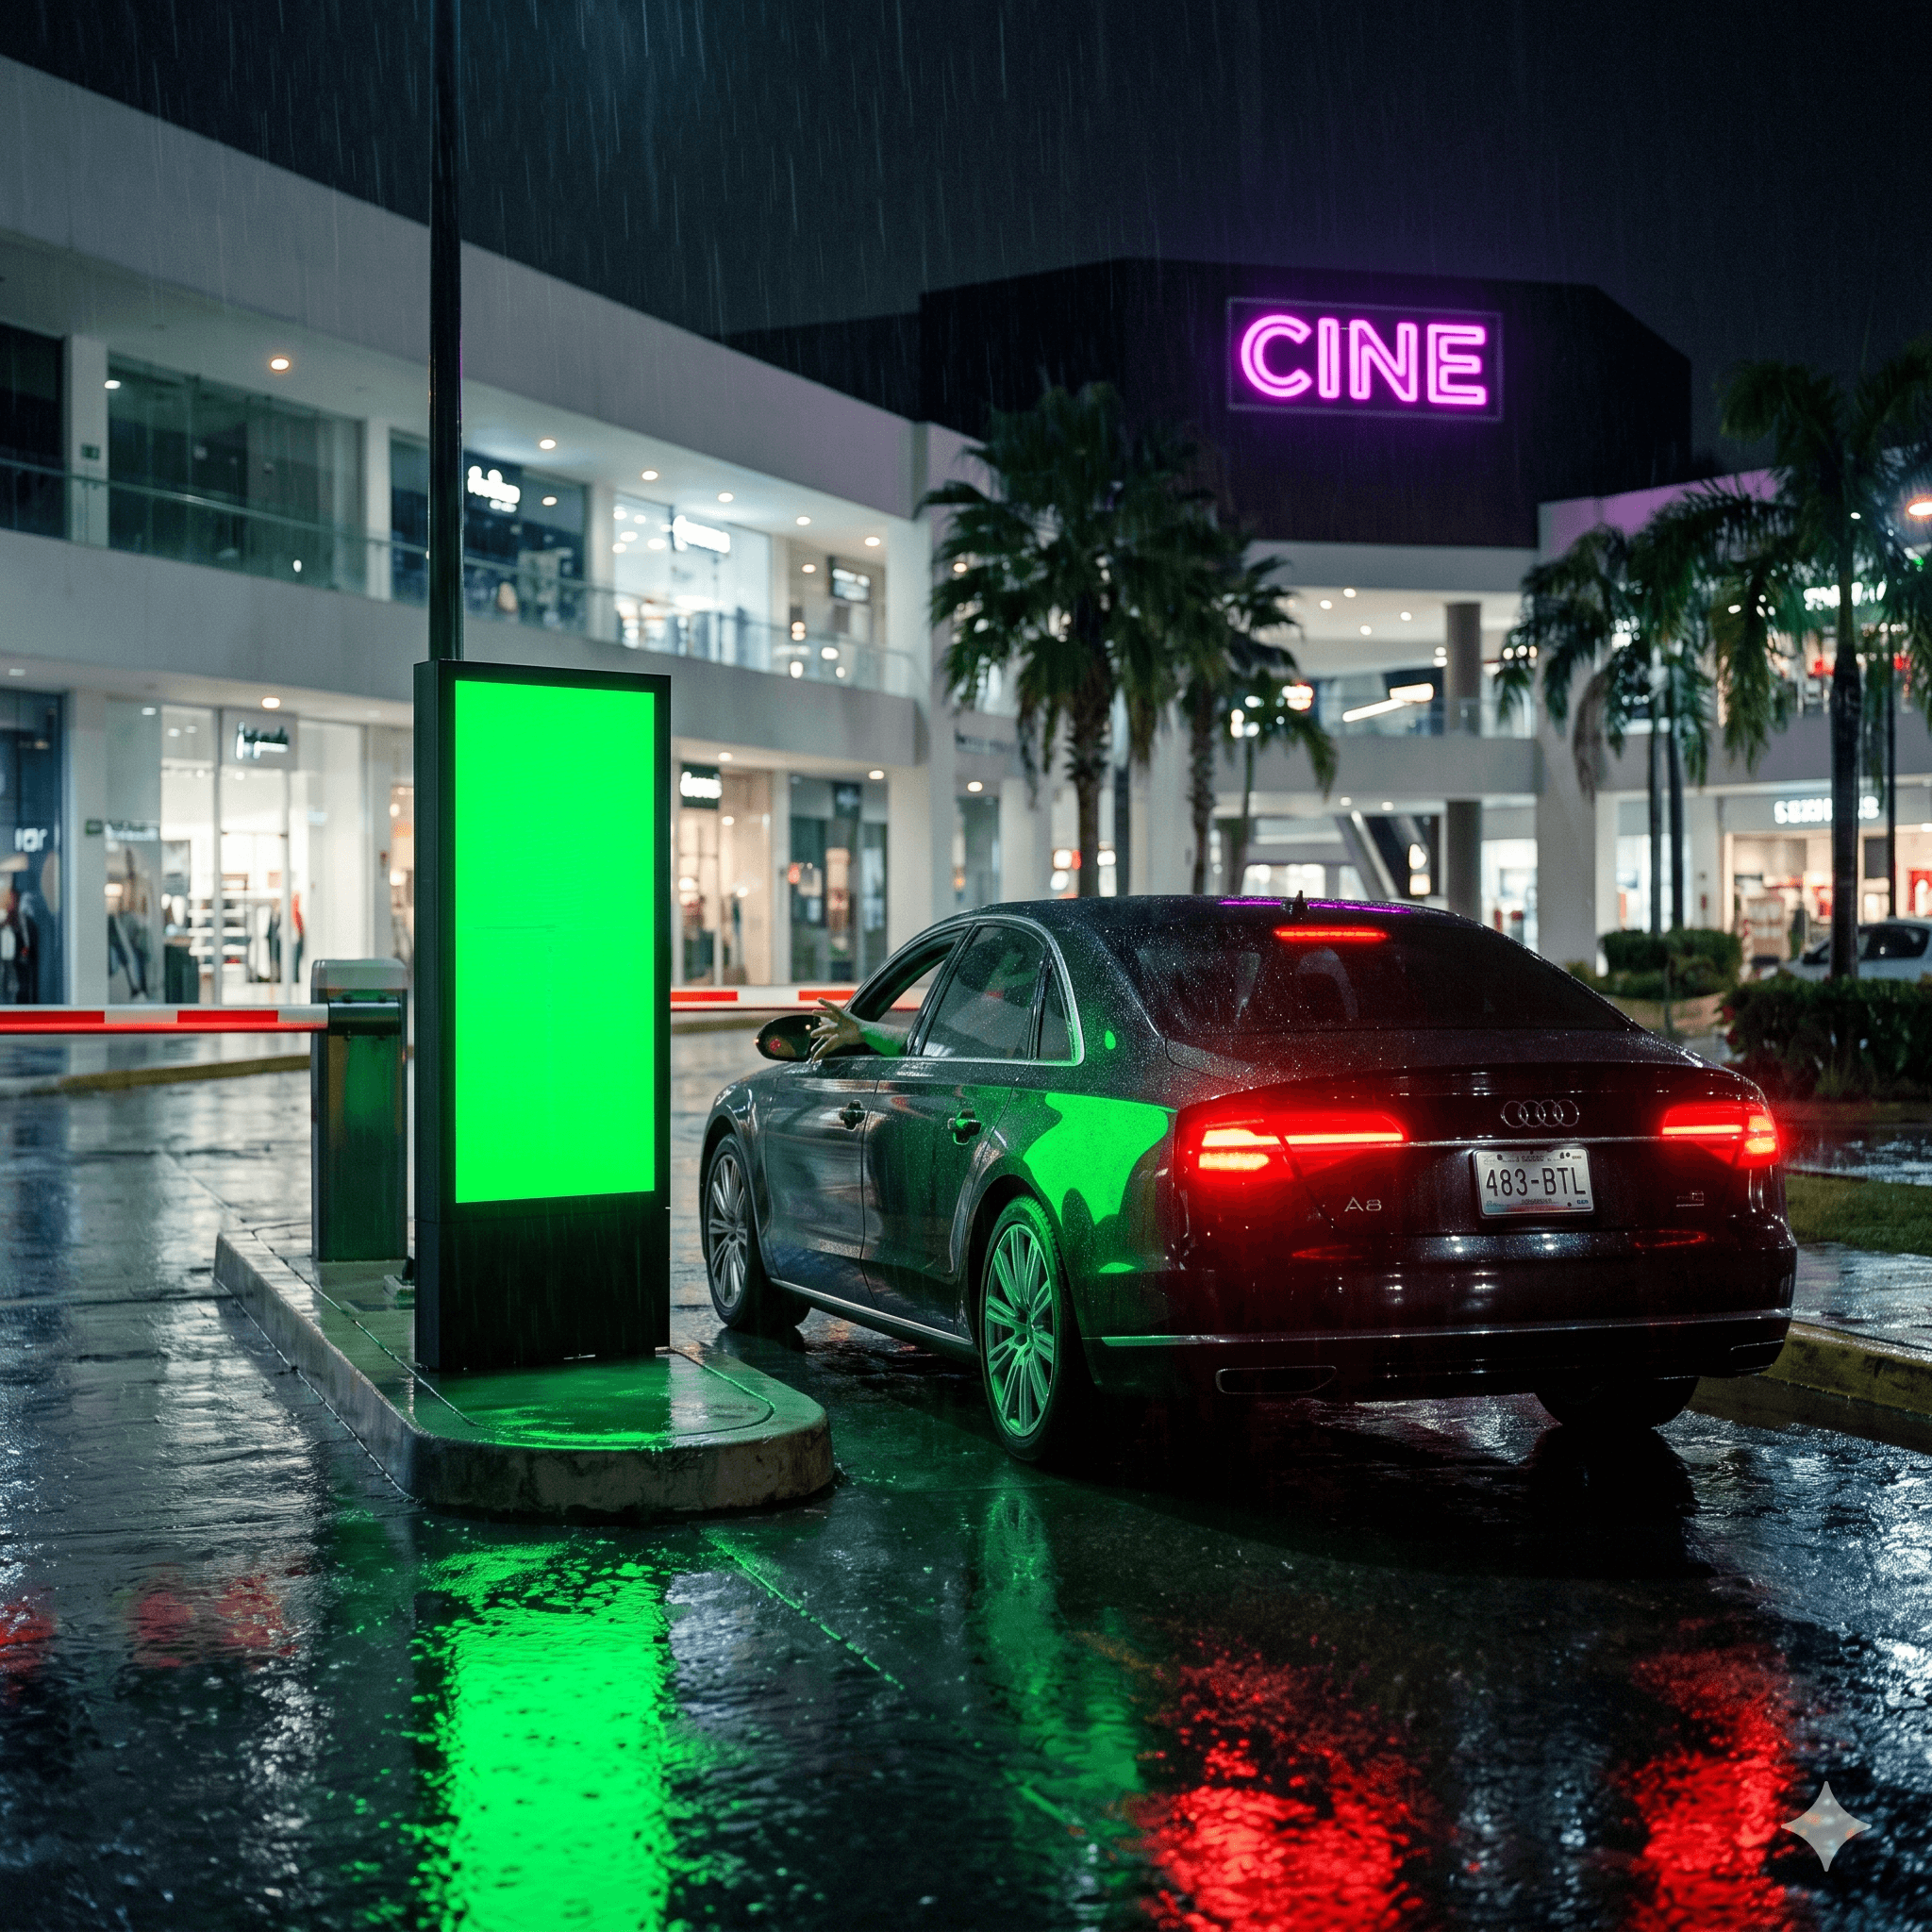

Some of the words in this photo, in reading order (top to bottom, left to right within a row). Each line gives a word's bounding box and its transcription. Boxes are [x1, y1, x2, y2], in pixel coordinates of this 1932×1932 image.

[1241, 315, 1487, 406] CINE
[1486, 1166, 1586, 1197] 483-BTL
[1344, 1196, 1382, 1212] A8
